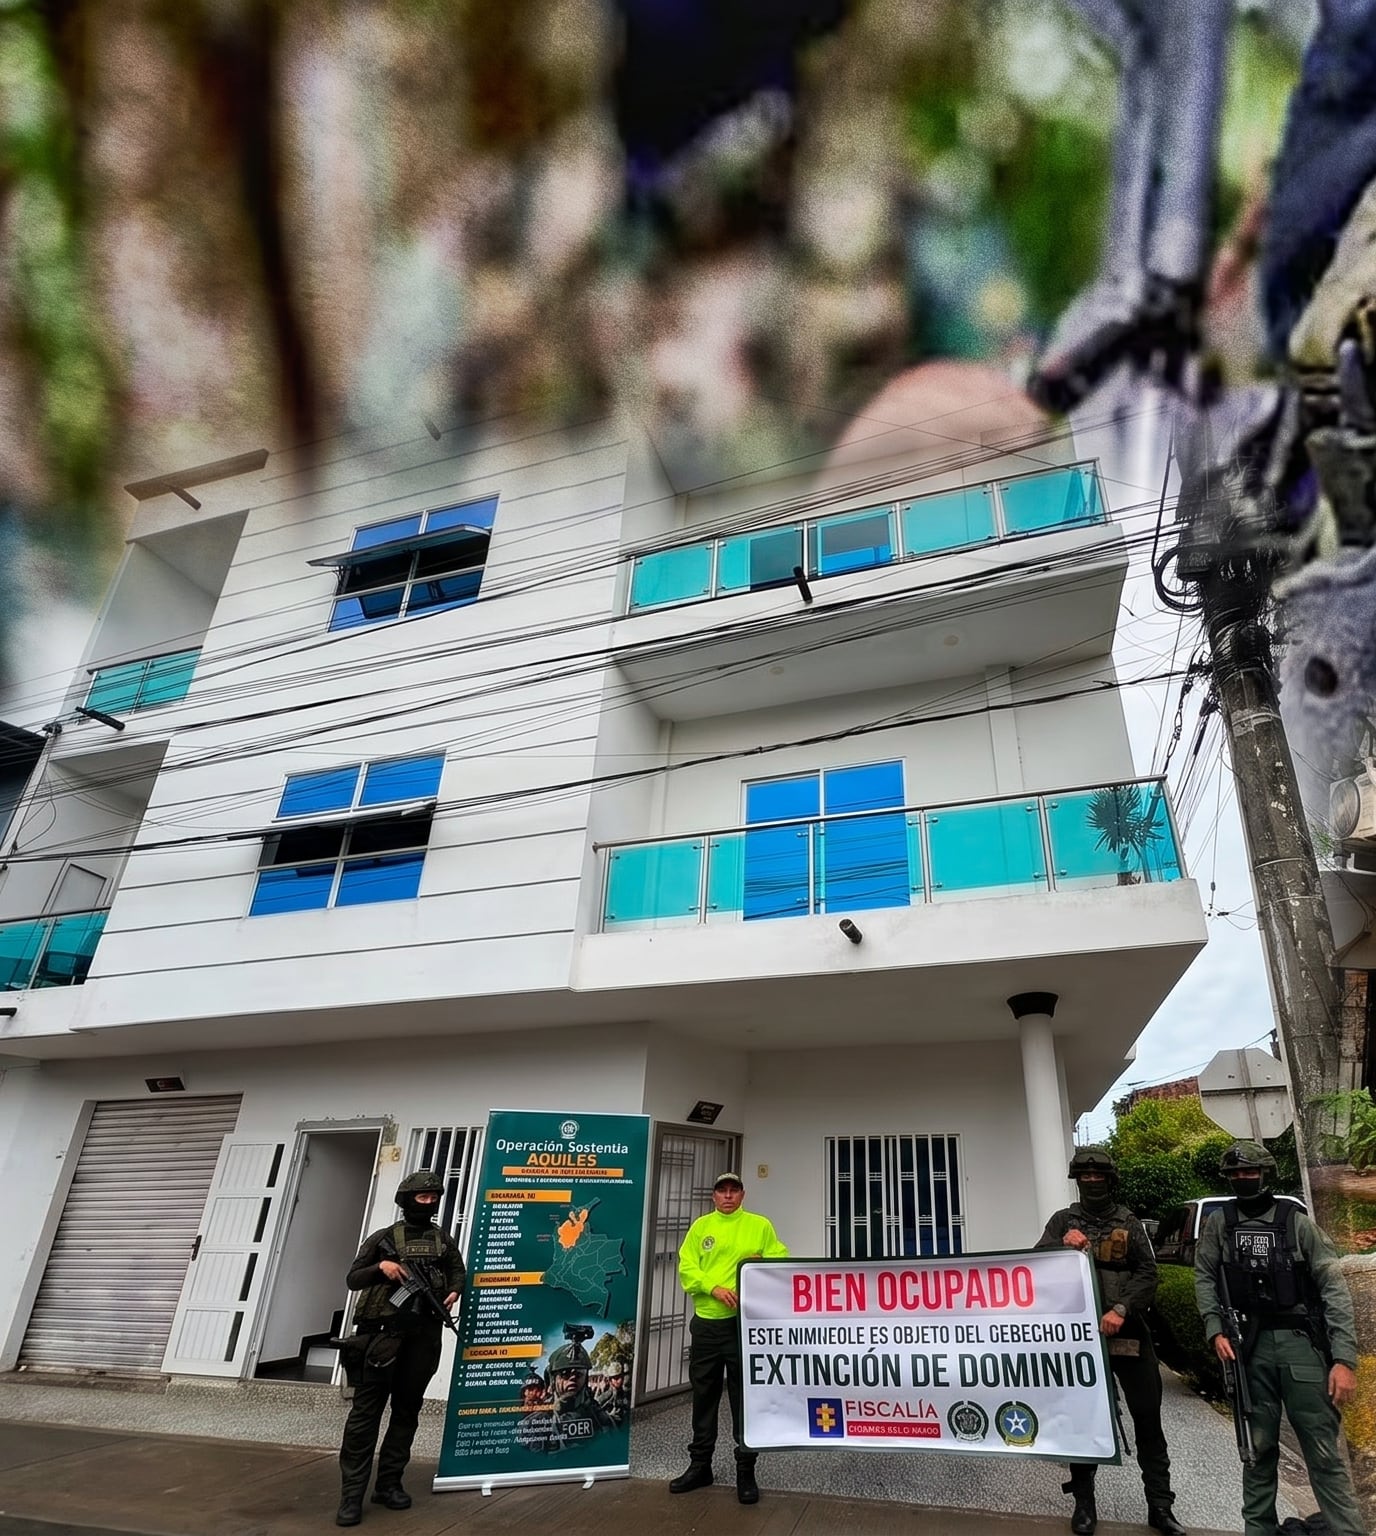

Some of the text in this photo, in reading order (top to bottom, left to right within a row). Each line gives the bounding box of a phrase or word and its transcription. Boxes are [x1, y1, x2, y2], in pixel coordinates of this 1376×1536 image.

[496, 1139, 563, 1153] Operación
[526, 1153, 597, 1167] AQUILES
[792, 1266, 1034, 1312] BIEN OCUPADO
[749, 1327, 783, 1345] ESTE
[870, 1326, 889, 1344] ES
[893, 1325, 950, 1344] OBJETO
[955, 1324, 985, 1344] DEL
[1071, 1322, 1094, 1342] DE
[749, 1347, 1097, 1389] EXTINCIÓN DE DOMINIO
[845, 1398, 938, 1418] FISCALÍA
